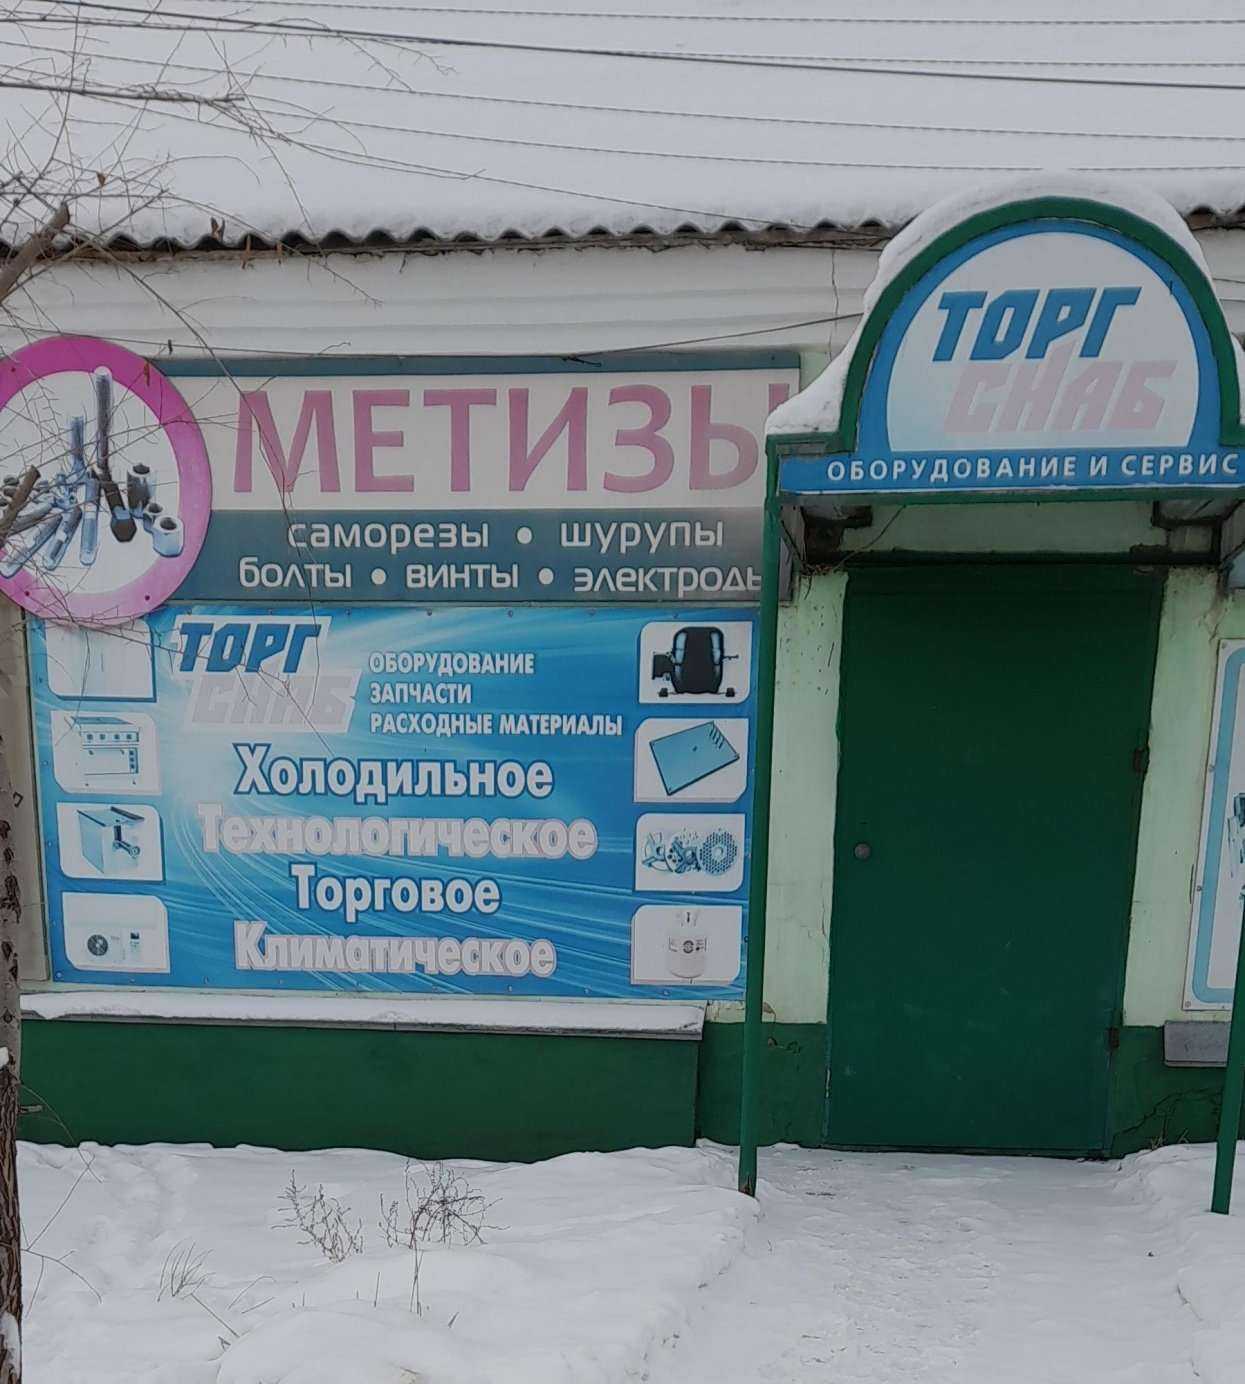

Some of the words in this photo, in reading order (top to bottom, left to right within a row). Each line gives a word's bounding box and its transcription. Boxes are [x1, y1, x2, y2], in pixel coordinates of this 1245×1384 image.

[932, 286, 1142, 362] ТОРГ
[944, 342, 1177, 434] СНАБ
[233, 383, 790, 493] МЕТИЗЫ
[826, 455, 1077, 482] ОБОРУДОВАНИЕ
[1088, 456, 1108, 476] И
[1121, 453, 1239, 476] СЕРВИС
[287, 522, 489, 555] саморезы
[560, 521, 723, 554] шурупы
[239, 557, 351, 588] болты
[406, 563, 519, 589] винты
[179, 622, 322, 673] ТОРГ
[368, 652, 535, 677] ОБОРУДОВАНИЕ
[369, 682, 473, 704] ЗАПЧАСТИ
[370, 713, 494, 737] РАСХОДНЫЕ
[499, 715, 623, 736] МАТЕРИАЛЫ
[233, 743, 554, 804] Холодильное
[199, 804, 599, 859] Технологическое
[290, 862, 501, 923] Торговое
[233, 920, 557, 978] Климатическое
